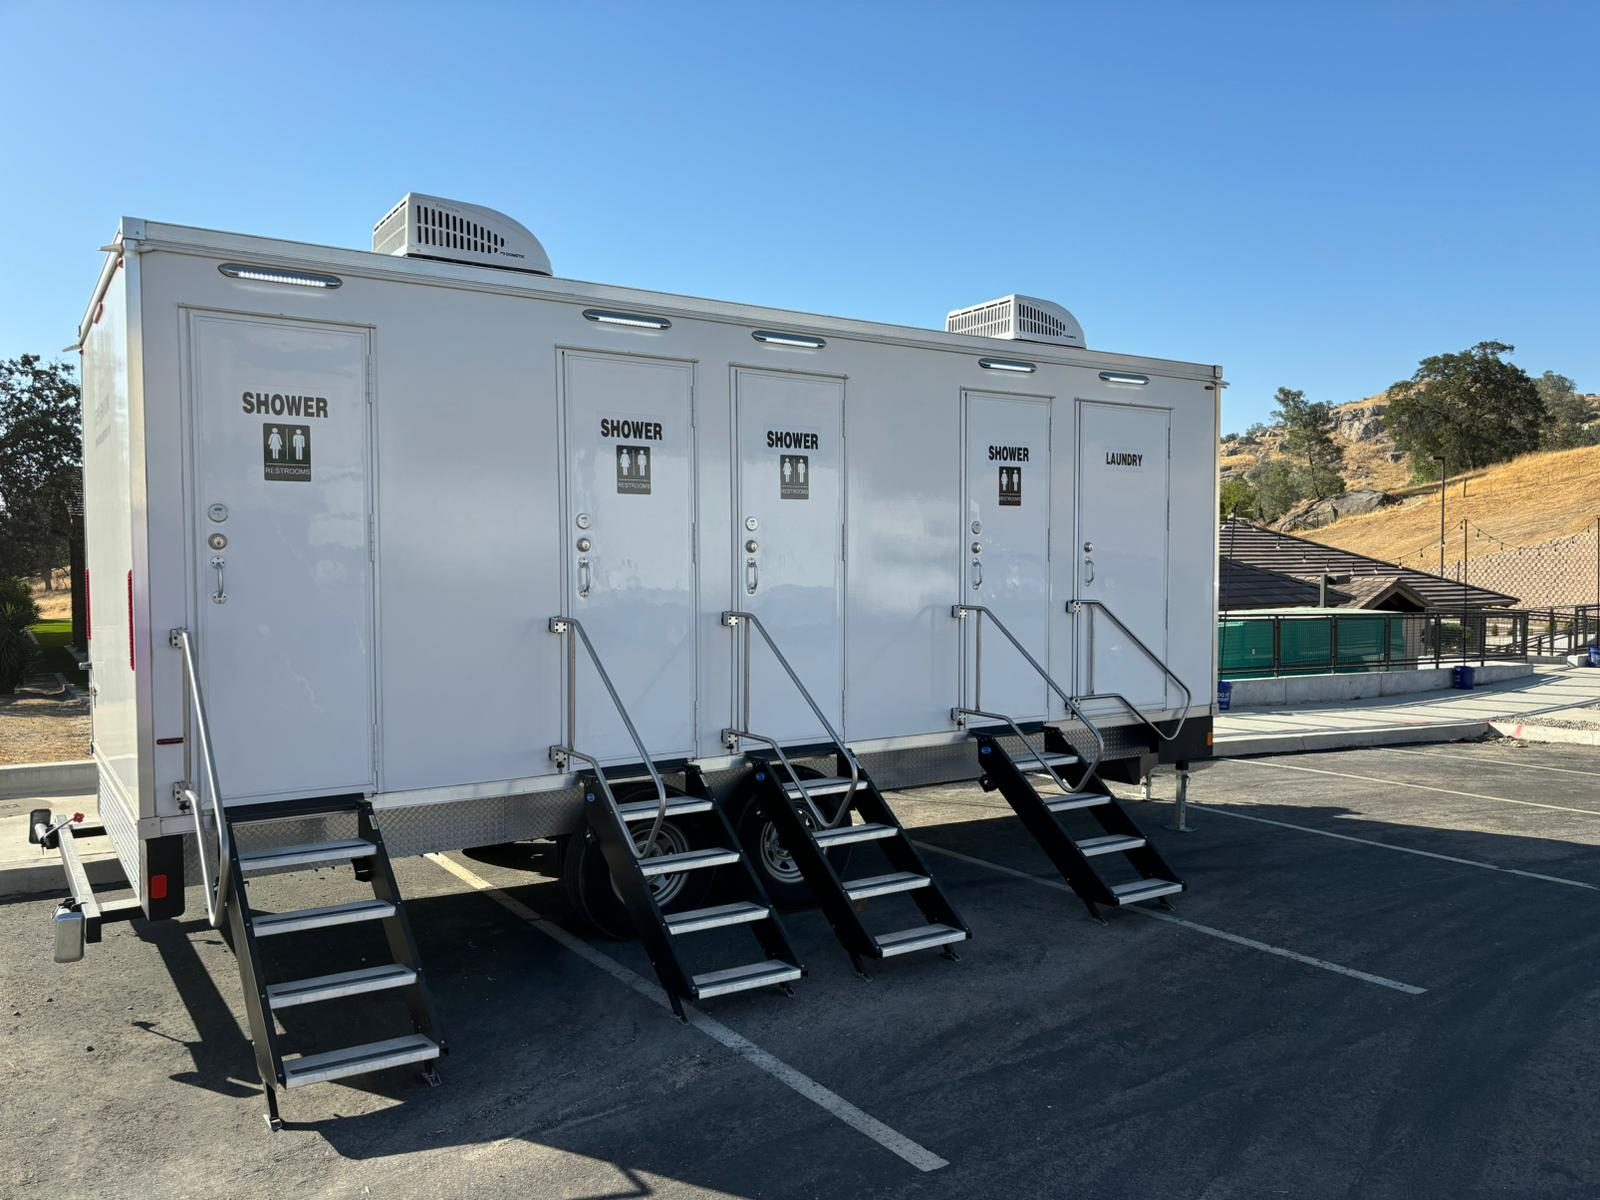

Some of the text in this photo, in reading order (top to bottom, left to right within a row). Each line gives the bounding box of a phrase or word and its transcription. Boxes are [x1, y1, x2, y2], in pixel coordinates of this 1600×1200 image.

[242, 391, 328, 418] SHOWER
[600, 418, 662, 440] SHOWER
[767, 430, 819, 450] SHOWER
[988, 445, 1029, 462] SHOWER
[1106, 451, 1143, 467] LAUNDRY
[265, 466, 311, 475] RESTROOMS
